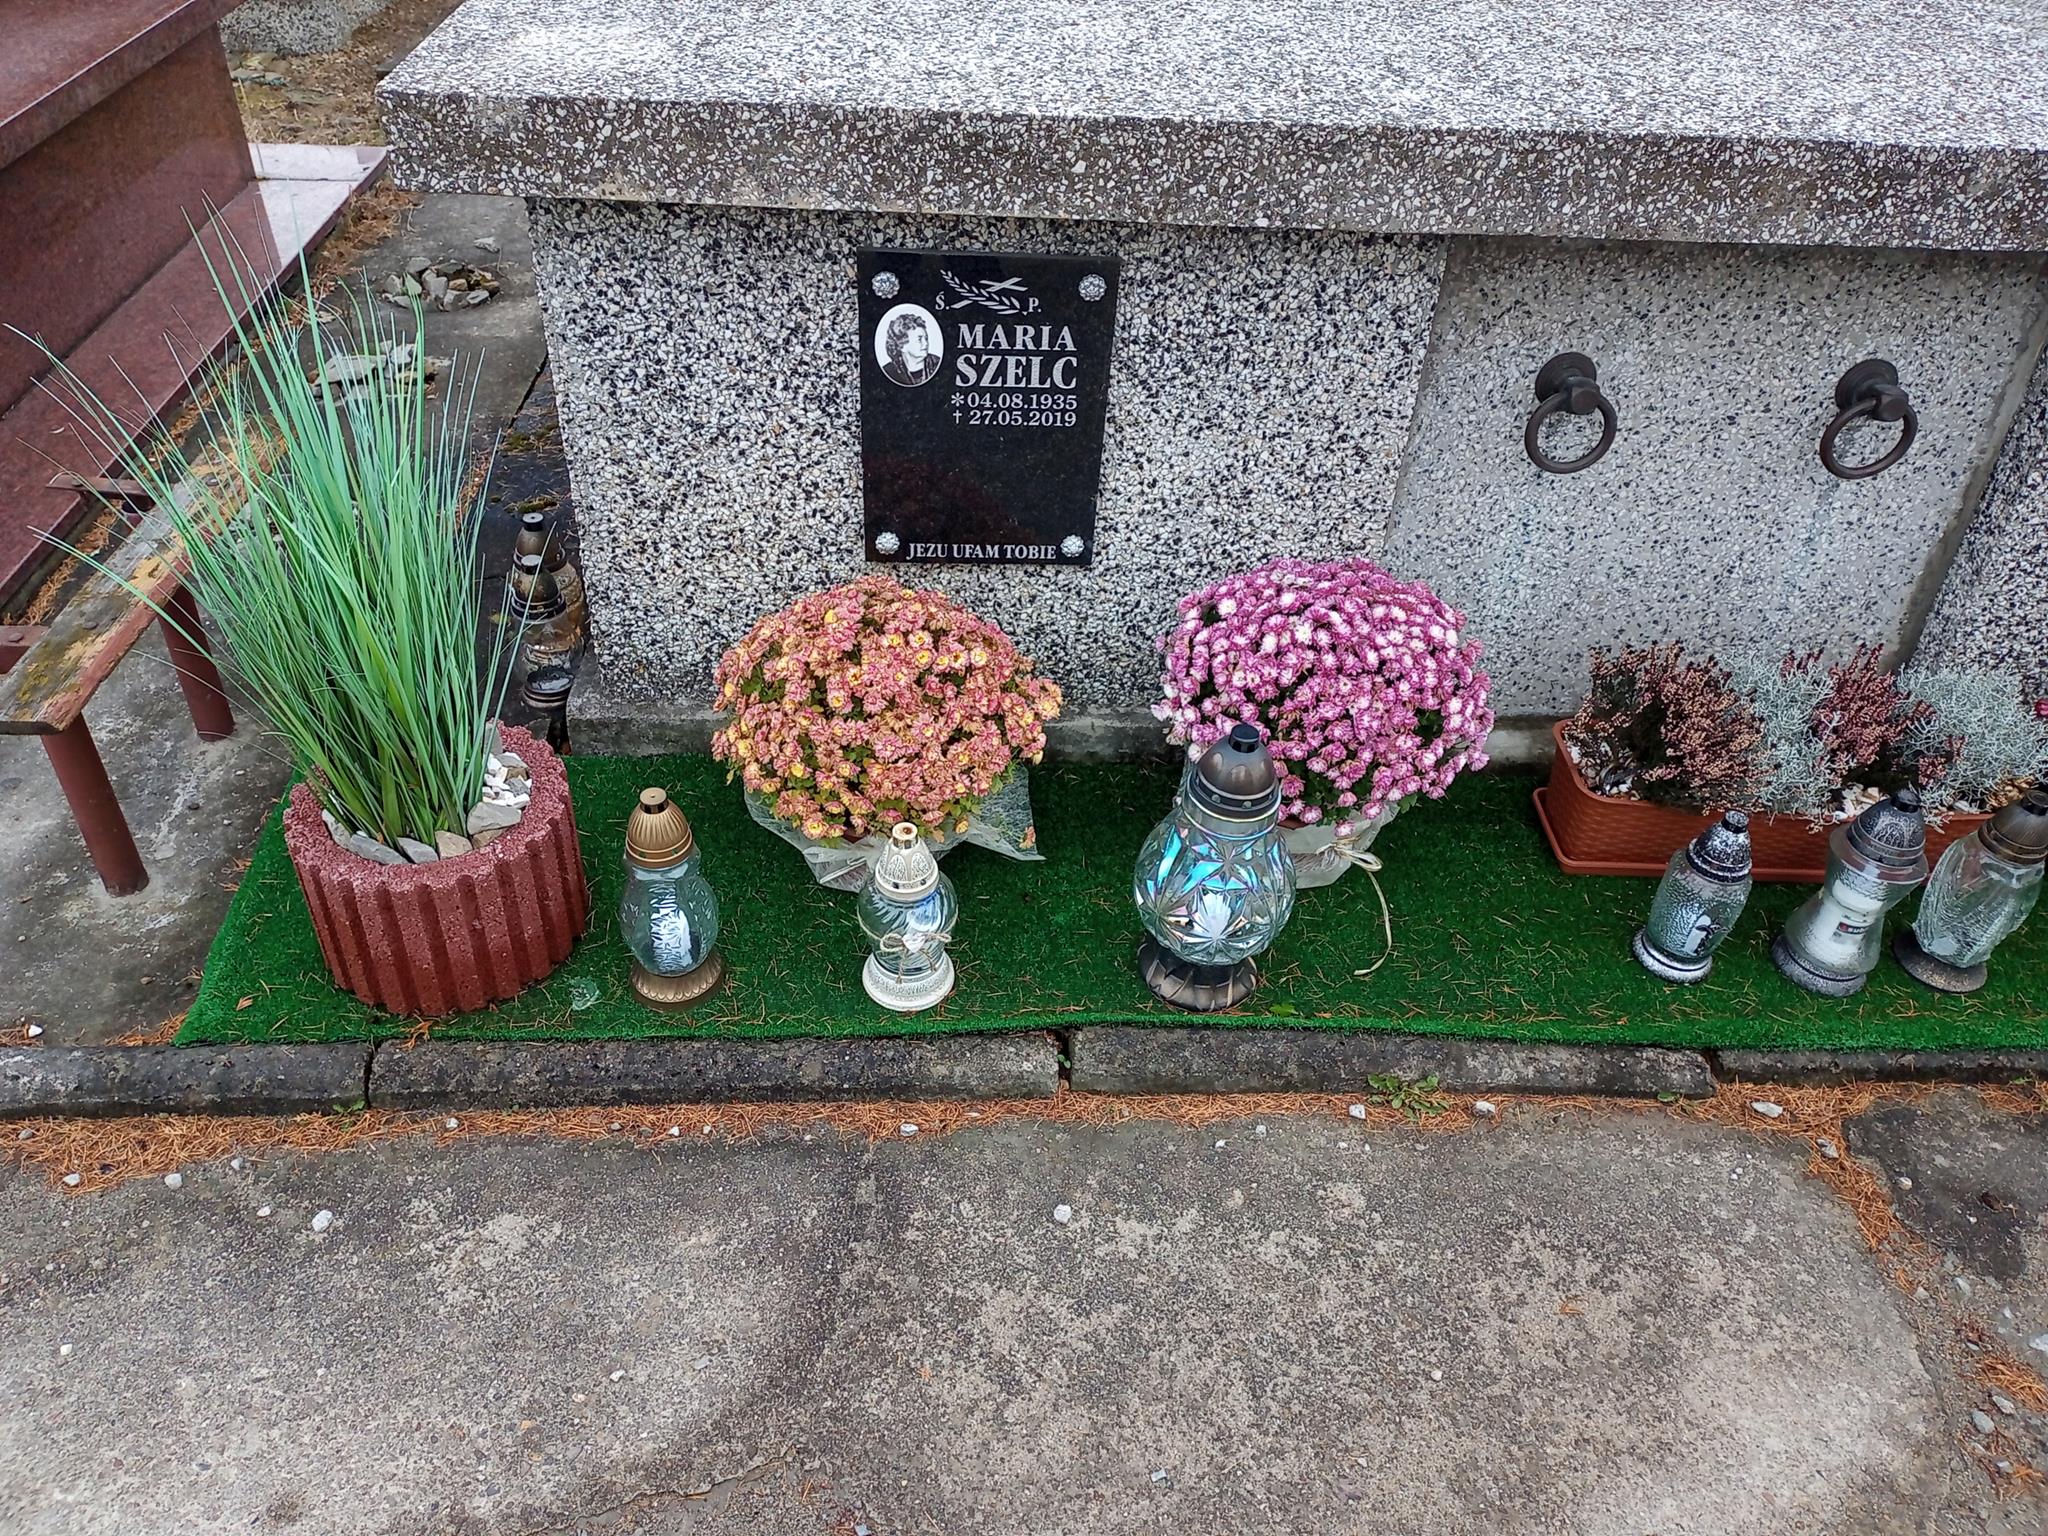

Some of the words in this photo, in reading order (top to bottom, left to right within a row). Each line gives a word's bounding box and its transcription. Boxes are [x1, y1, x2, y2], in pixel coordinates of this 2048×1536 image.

[935, 291, 950, 311] Ś.
[1028, 297, 1042, 313] P.
[957, 323, 1078, 351] MARIA
[955, 353, 1078, 390] SZELC
[906, 543, 948, 560] JEZU
[952, 543, 1000, 559] UFAM
[1003, 544, 1057, 560] TOBIE
